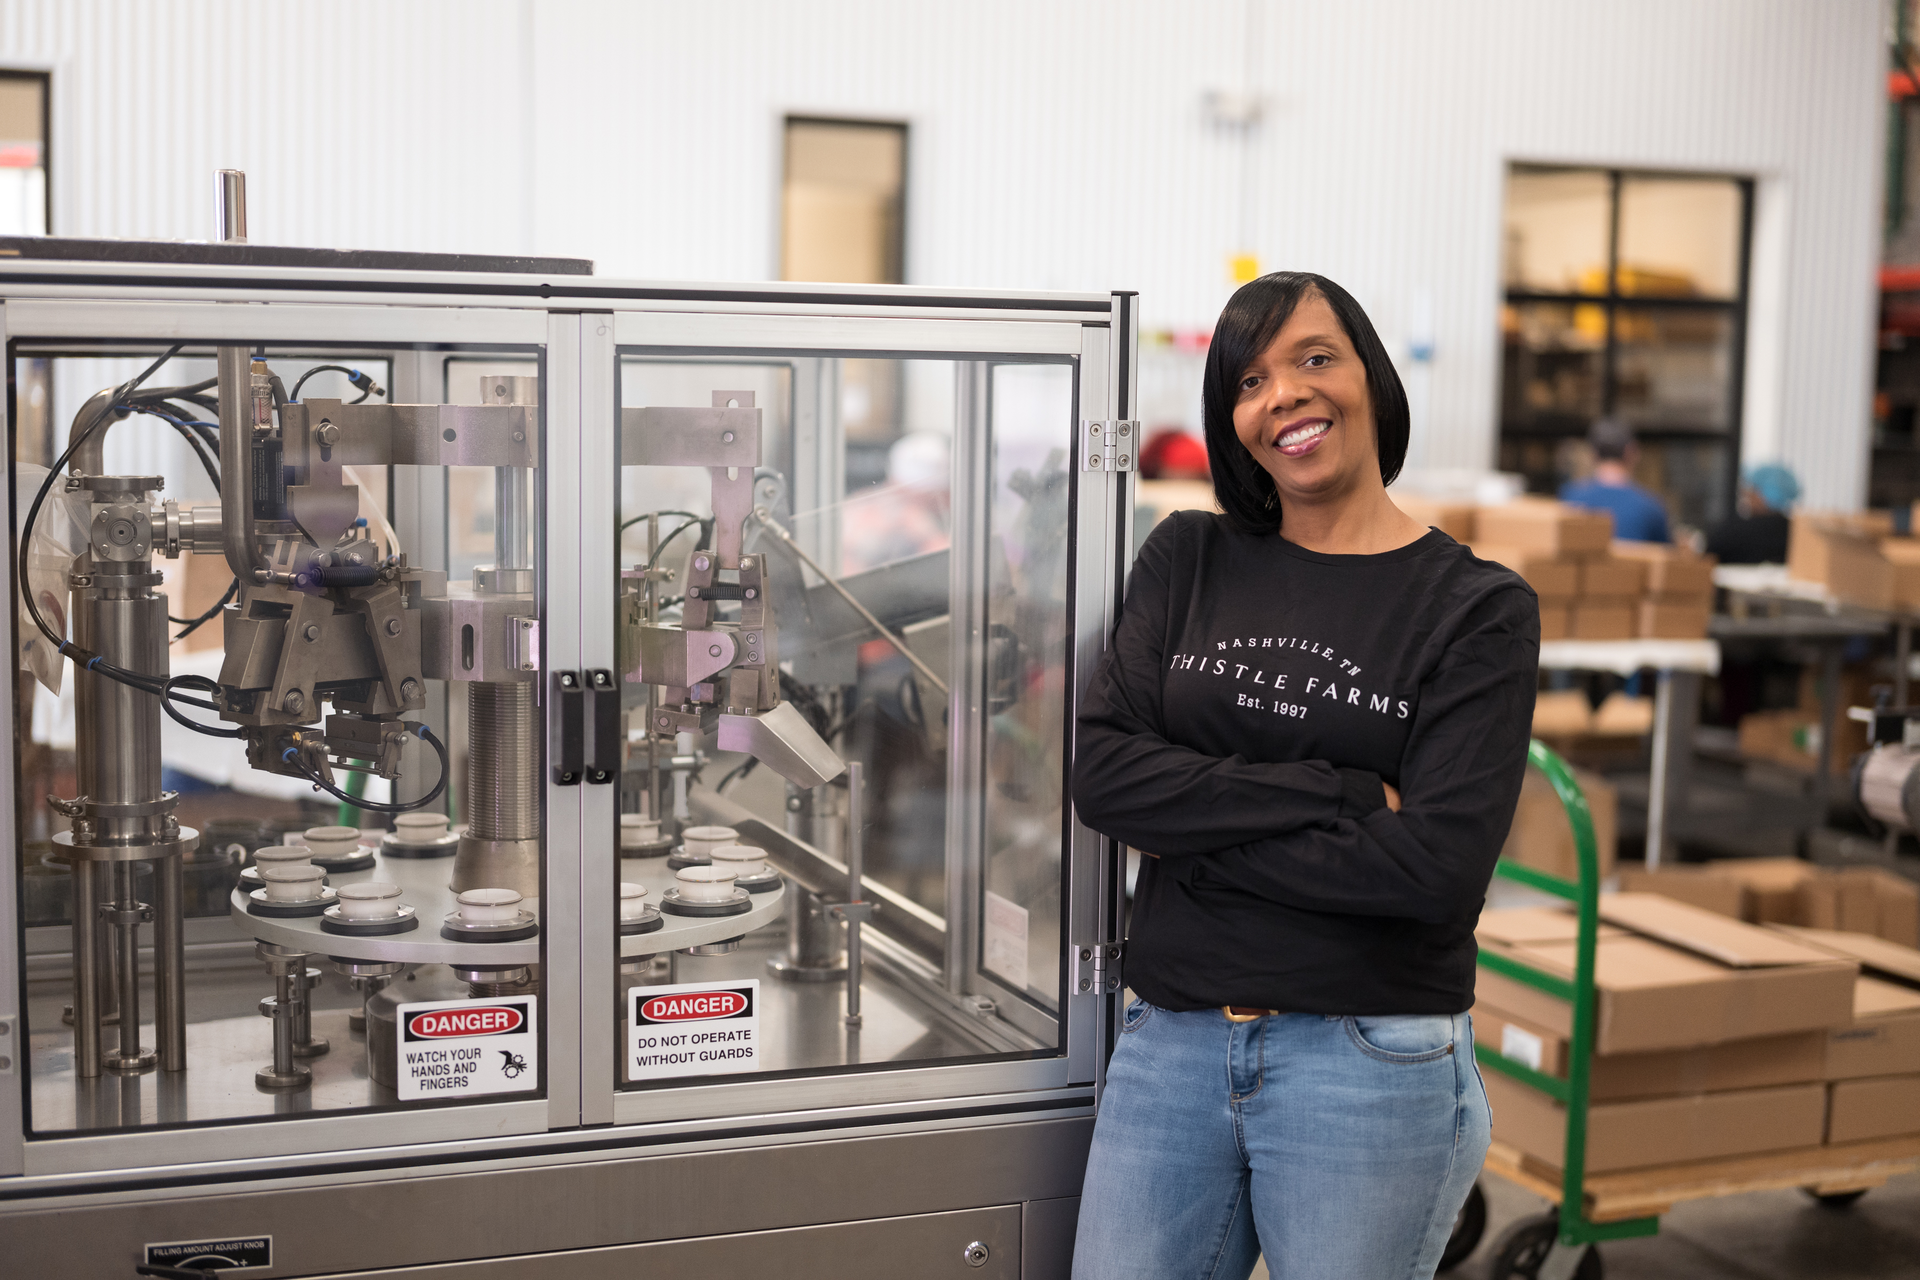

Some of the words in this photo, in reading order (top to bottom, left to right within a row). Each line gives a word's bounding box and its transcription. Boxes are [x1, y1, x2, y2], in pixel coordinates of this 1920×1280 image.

[1217, 638, 1333, 661] NASHVILLE,
[1339, 659, 1362, 676] TN
[1170, 654, 1288, 689] THISTLE
[1305, 678, 1409, 719] FARMS
[1237, 694, 1264, 710] Est.
[1273, 701, 1307, 719] 1997
[653, 997, 734, 1018] DANGER
[422, 1012, 509, 1034] DANGER
[638, 1037, 657, 1049] DO
[661, 1034, 689, 1047] NOT
[692, 1030, 752, 1045] OPERATE
[406, 1051, 448, 1064] WATCH
[451, 1048, 482, 1062] YOUR
[636, 1052, 696, 1067] WITHOUT
[699, 1047, 753, 1062] GUARDS
[411, 1064, 450, 1078] HANDS
[453, 1062, 477, 1075] AND
[420, 1076, 469, 1091] FINGERS
[153, 1248, 182, 1257] FILLING
[183, 1245, 213, 1254] AMOUNT
[215, 1242, 243, 1252] ADJUST
[244, 1241, 265, 1249] KNOB
